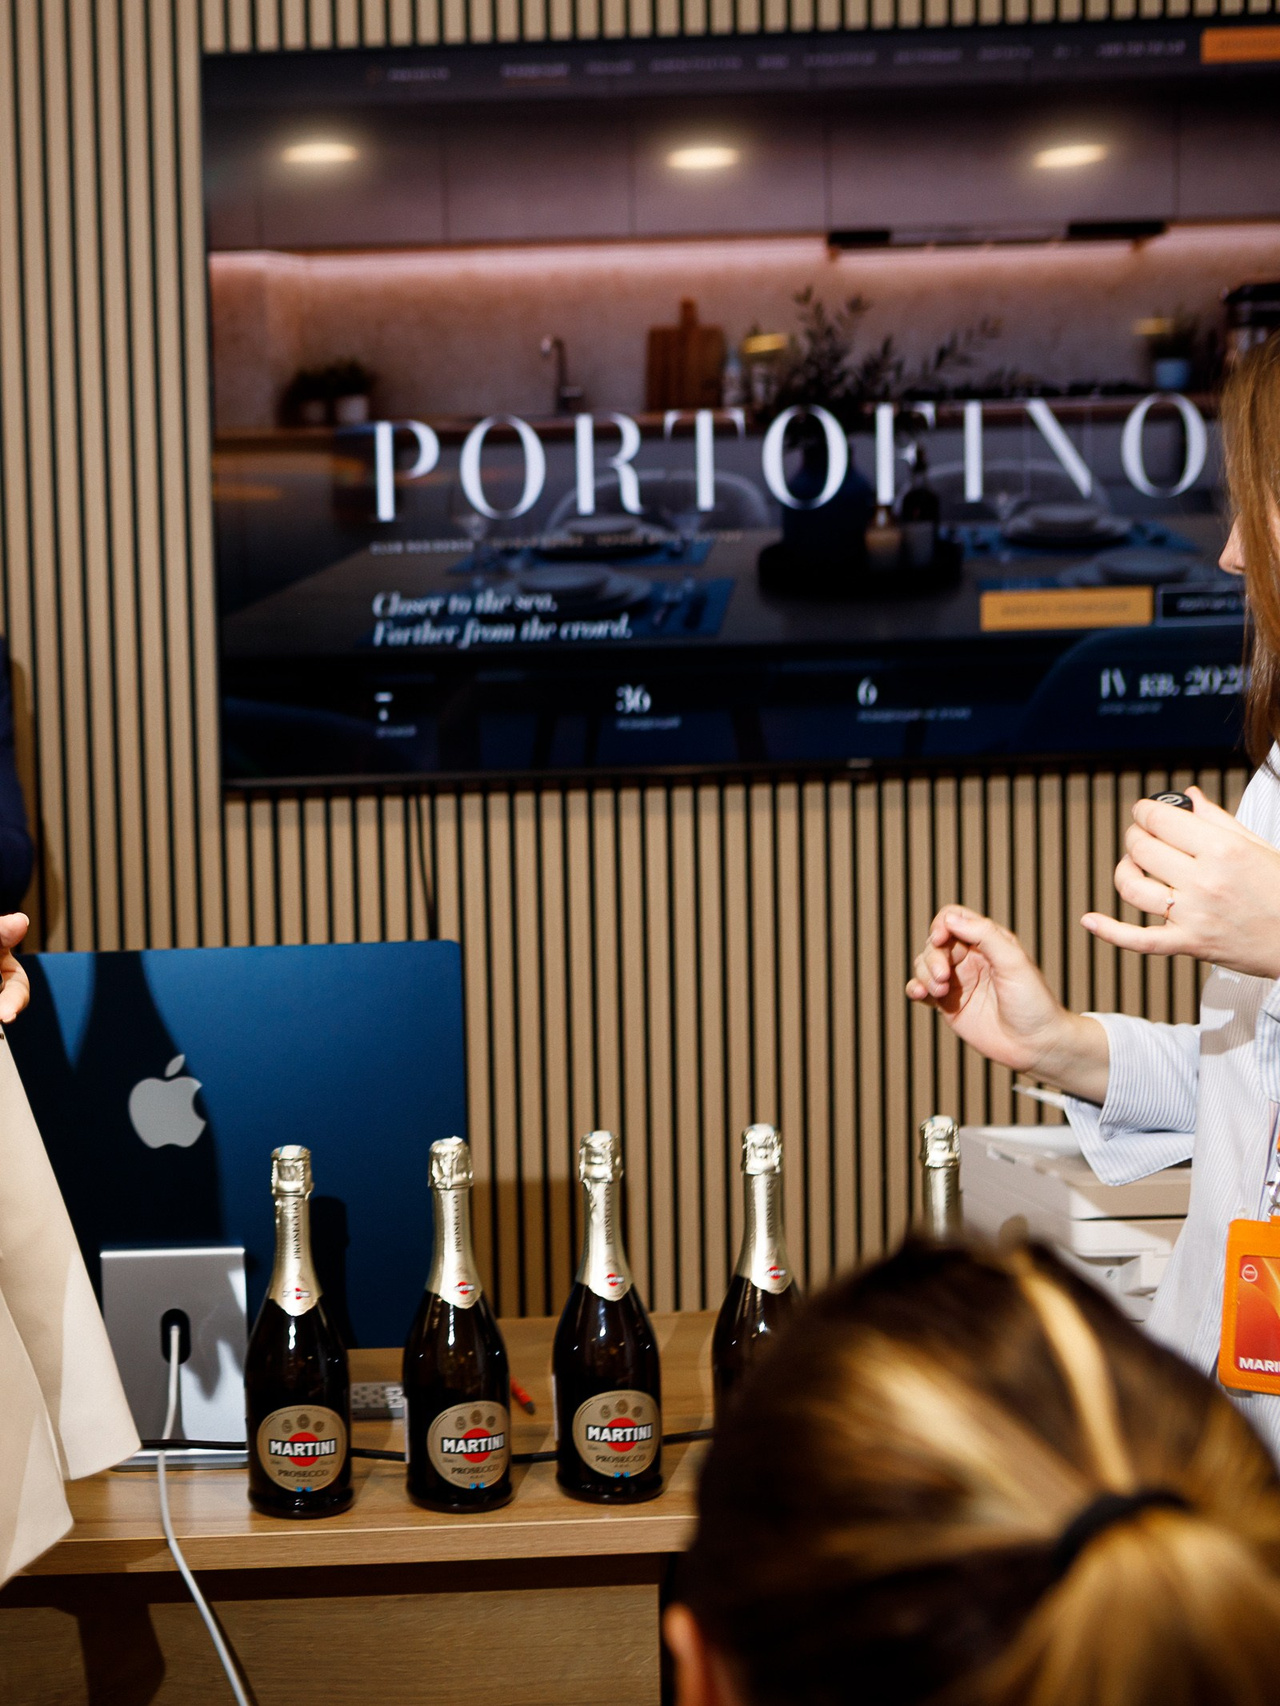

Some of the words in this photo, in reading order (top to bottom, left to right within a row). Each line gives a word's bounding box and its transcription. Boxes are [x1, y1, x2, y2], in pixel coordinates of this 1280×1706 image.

[375, 392, 1210, 524] PORTOFINO
[857, 676, 878, 706] 6
[1239, 1356, 1280, 1373] MARI
[587, 1424, 652, 1442] MARTINI
[270, 1440, 335, 1456] MARTINI
[443, 1433, 504, 1453] MARTINI
